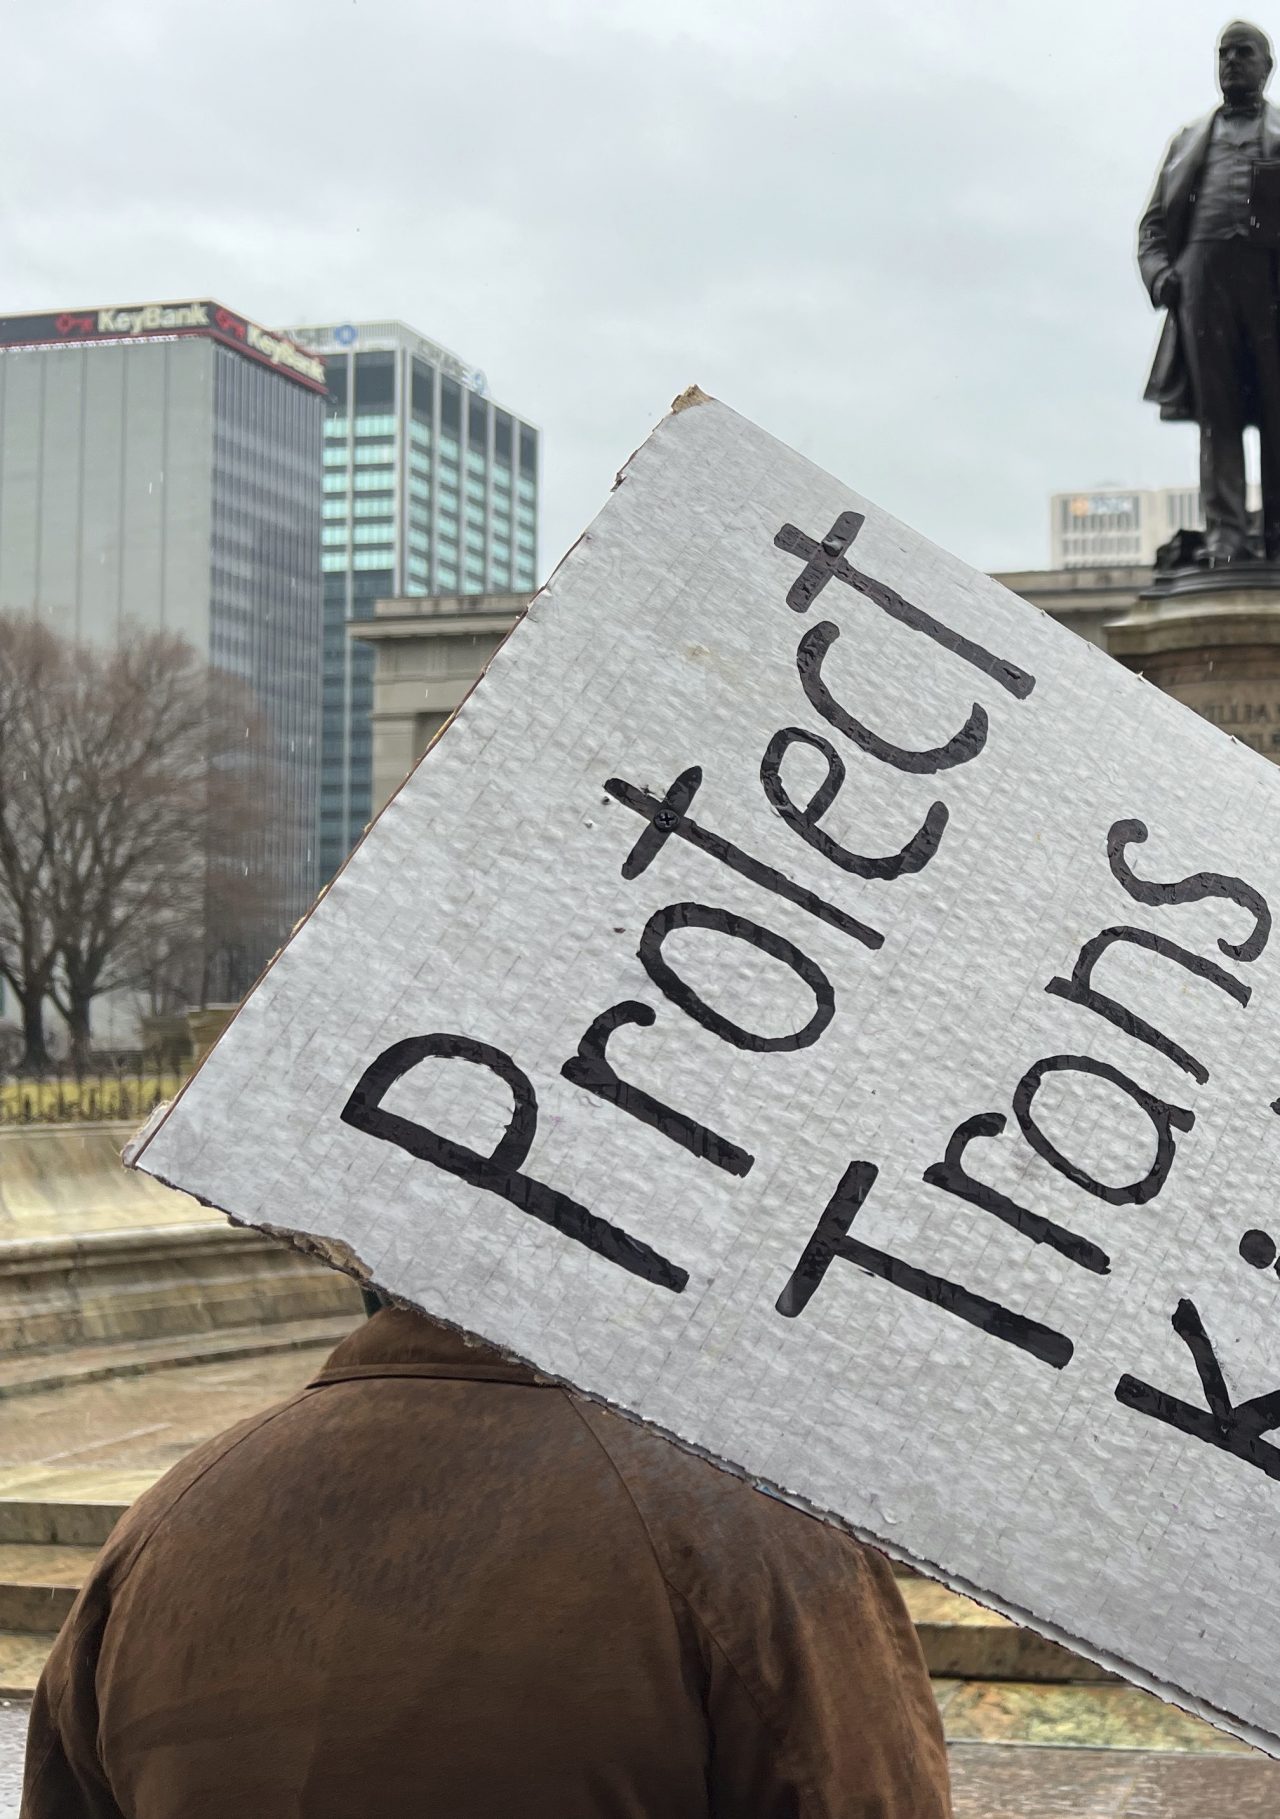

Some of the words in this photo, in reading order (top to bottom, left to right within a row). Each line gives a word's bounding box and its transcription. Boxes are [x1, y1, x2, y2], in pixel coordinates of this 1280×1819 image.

[98, 303, 209, 335] KeyBank
[247, 324, 326, 384] KeyBank
[340, 511, 1036, 1293] Protect
[775, 818, 1272, 1369] Trans
